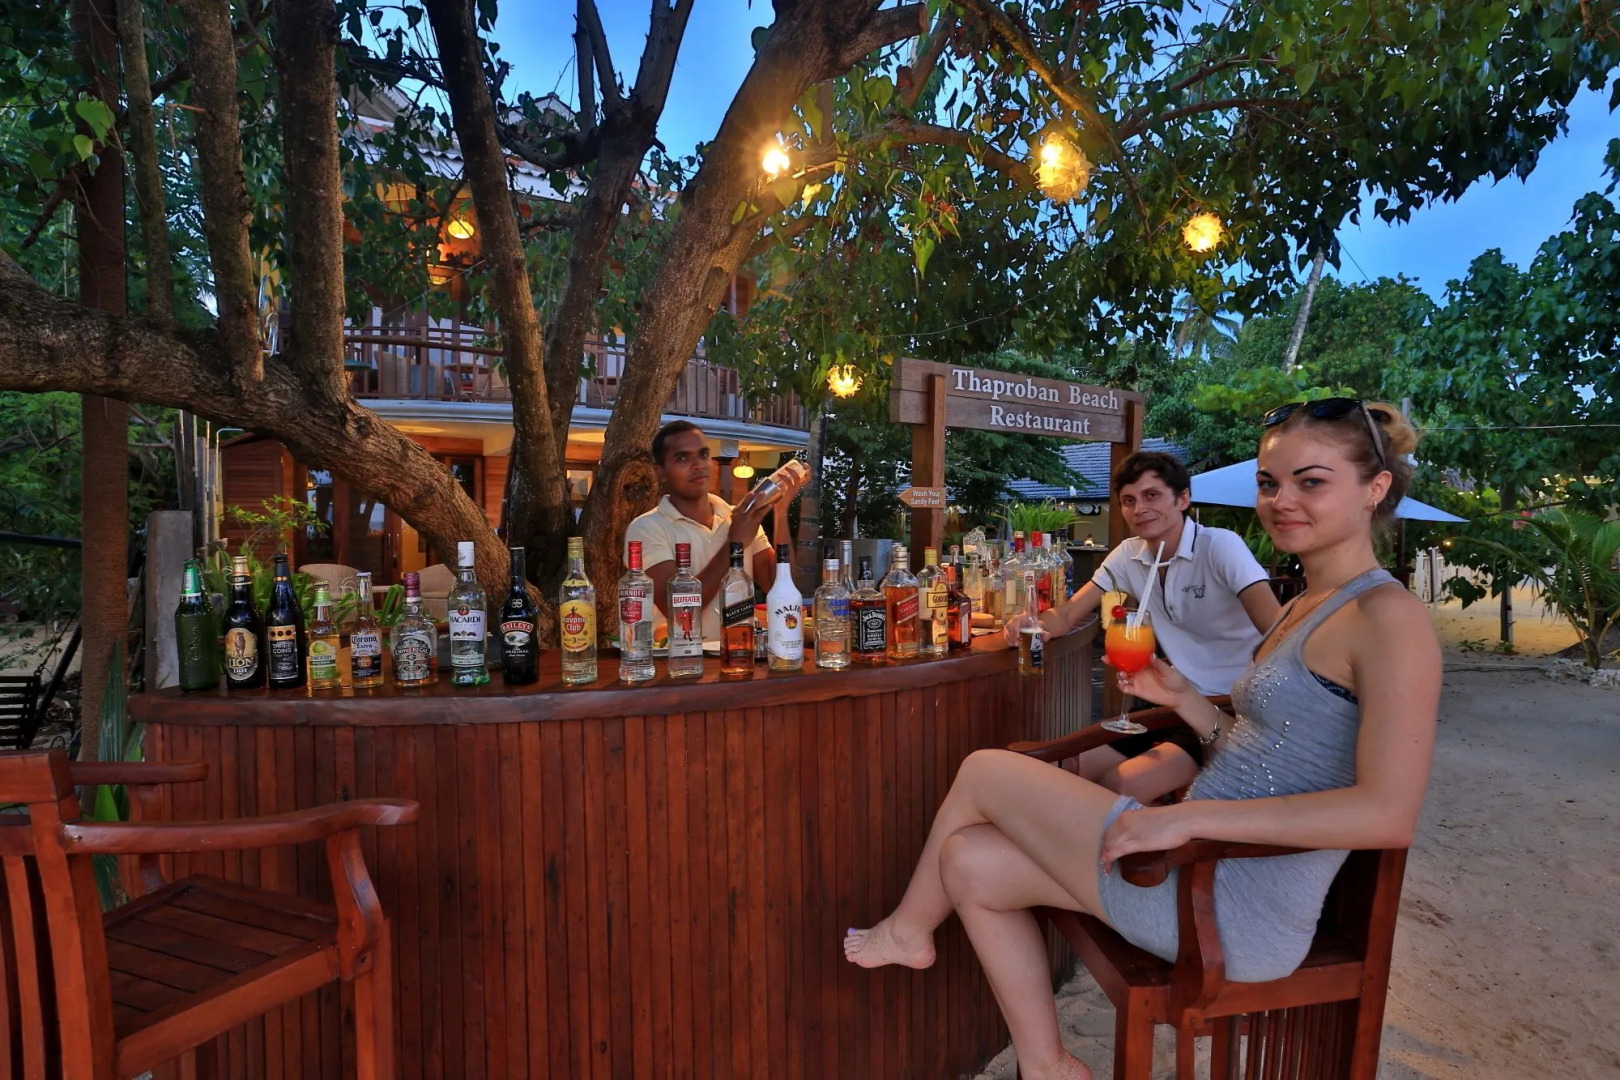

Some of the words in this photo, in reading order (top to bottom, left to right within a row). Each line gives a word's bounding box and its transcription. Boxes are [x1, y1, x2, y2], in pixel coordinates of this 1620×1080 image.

[952, 368, 1060, 403] Thaproban
[1068, 385, 1119, 410] Beach
[989, 405, 1090, 435] Restaurant
[911, 498, 927, 506] Sandy
[673, 596, 701, 604] BEEFEATER
[774, 604, 801, 617] MALIB
[502, 622, 531, 630] BAILEYS
[565, 623, 581, 631] Club
[352, 635, 378, 644] Corona
[229, 658, 257, 668] LION
